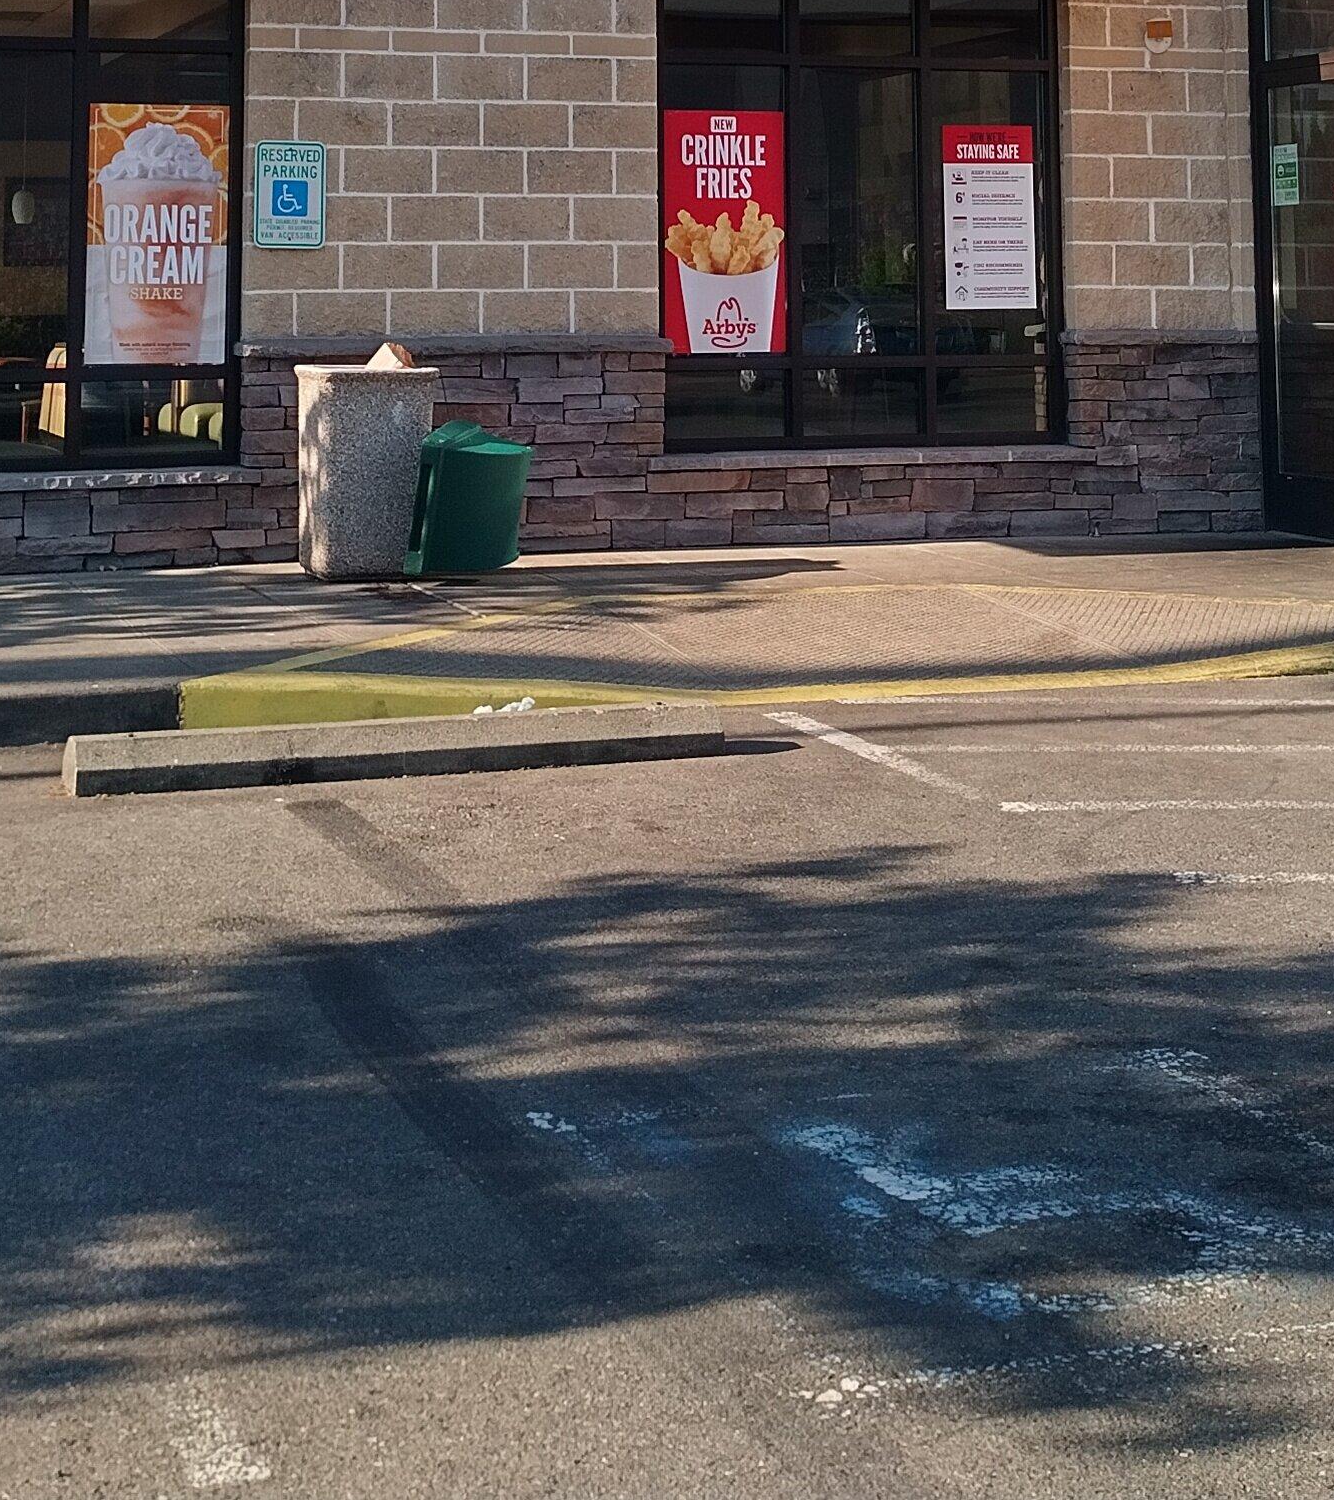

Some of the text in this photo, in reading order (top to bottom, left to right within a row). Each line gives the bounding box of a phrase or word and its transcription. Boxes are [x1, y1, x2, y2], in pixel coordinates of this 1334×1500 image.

[714, 119, 734, 130] NEW
[261, 148, 321, 162] RESERVED
[681, 134, 766, 166] CRINKLE
[956, 144, 1020, 159] STAYING SAFE
[264, 165, 318, 179] PARKING
[696, 167, 753, 199] FRIES
[104, 204, 213, 243] ORANGE
[260, 231, 319, 240] VAN ACCESSIBLE
[110, 246, 205, 285] CREAM
[130, 287, 184, 300] SHAKE
[702, 317, 757, 338] Arby's
